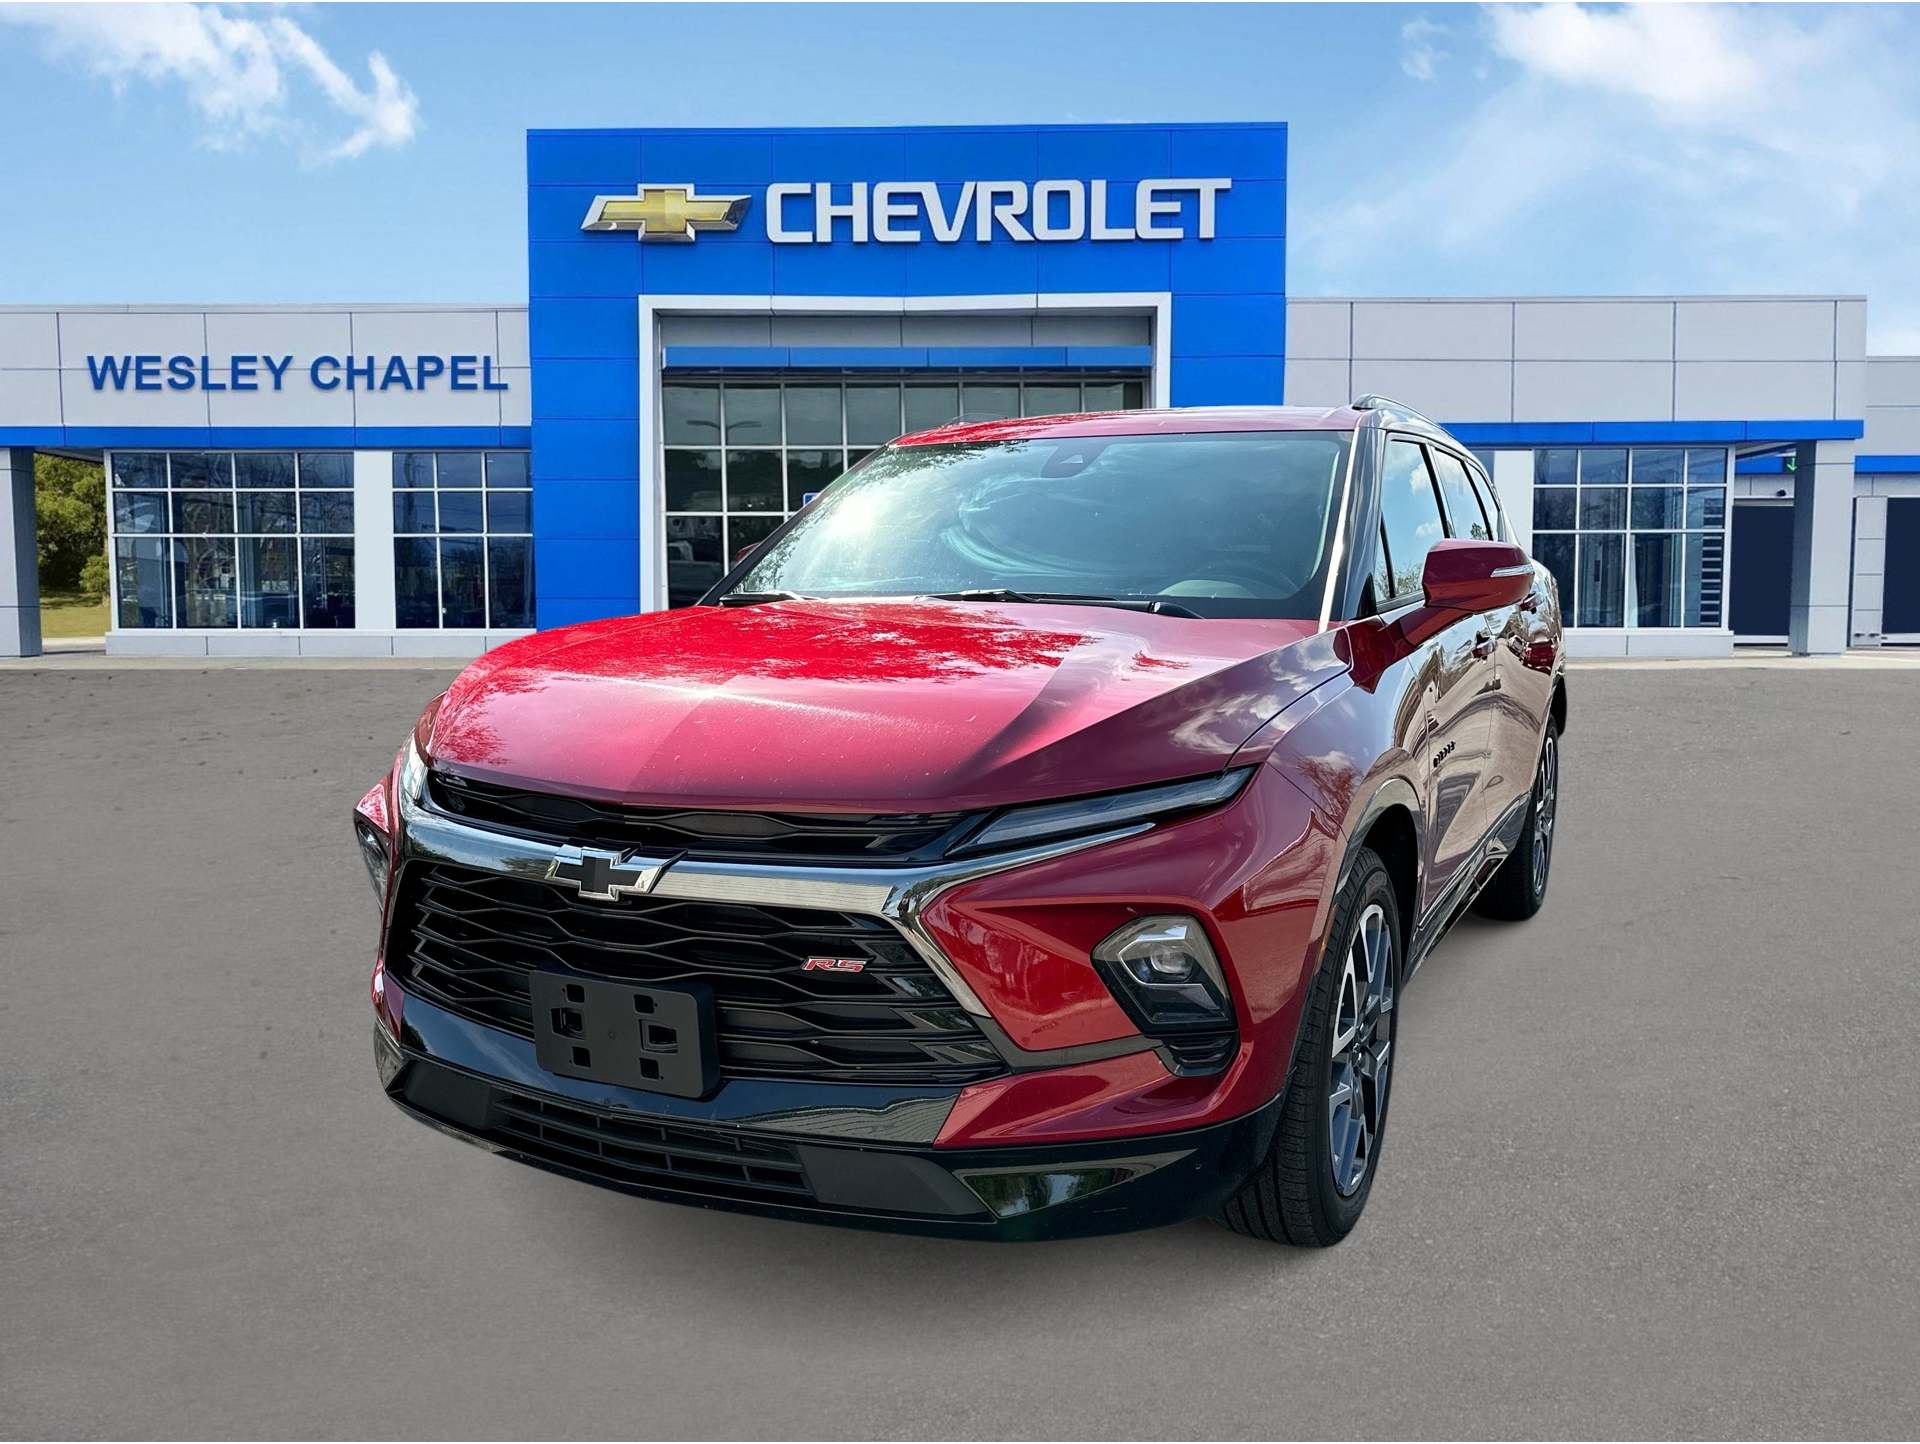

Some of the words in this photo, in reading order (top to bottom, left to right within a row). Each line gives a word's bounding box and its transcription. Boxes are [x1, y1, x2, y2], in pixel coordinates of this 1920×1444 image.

[766, 178, 1232, 243] CHEVROLET
[87, 355, 293, 390] WESLEY
[310, 355, 508, 390] CHAPEL
[802, 958, 867, 973] RS
